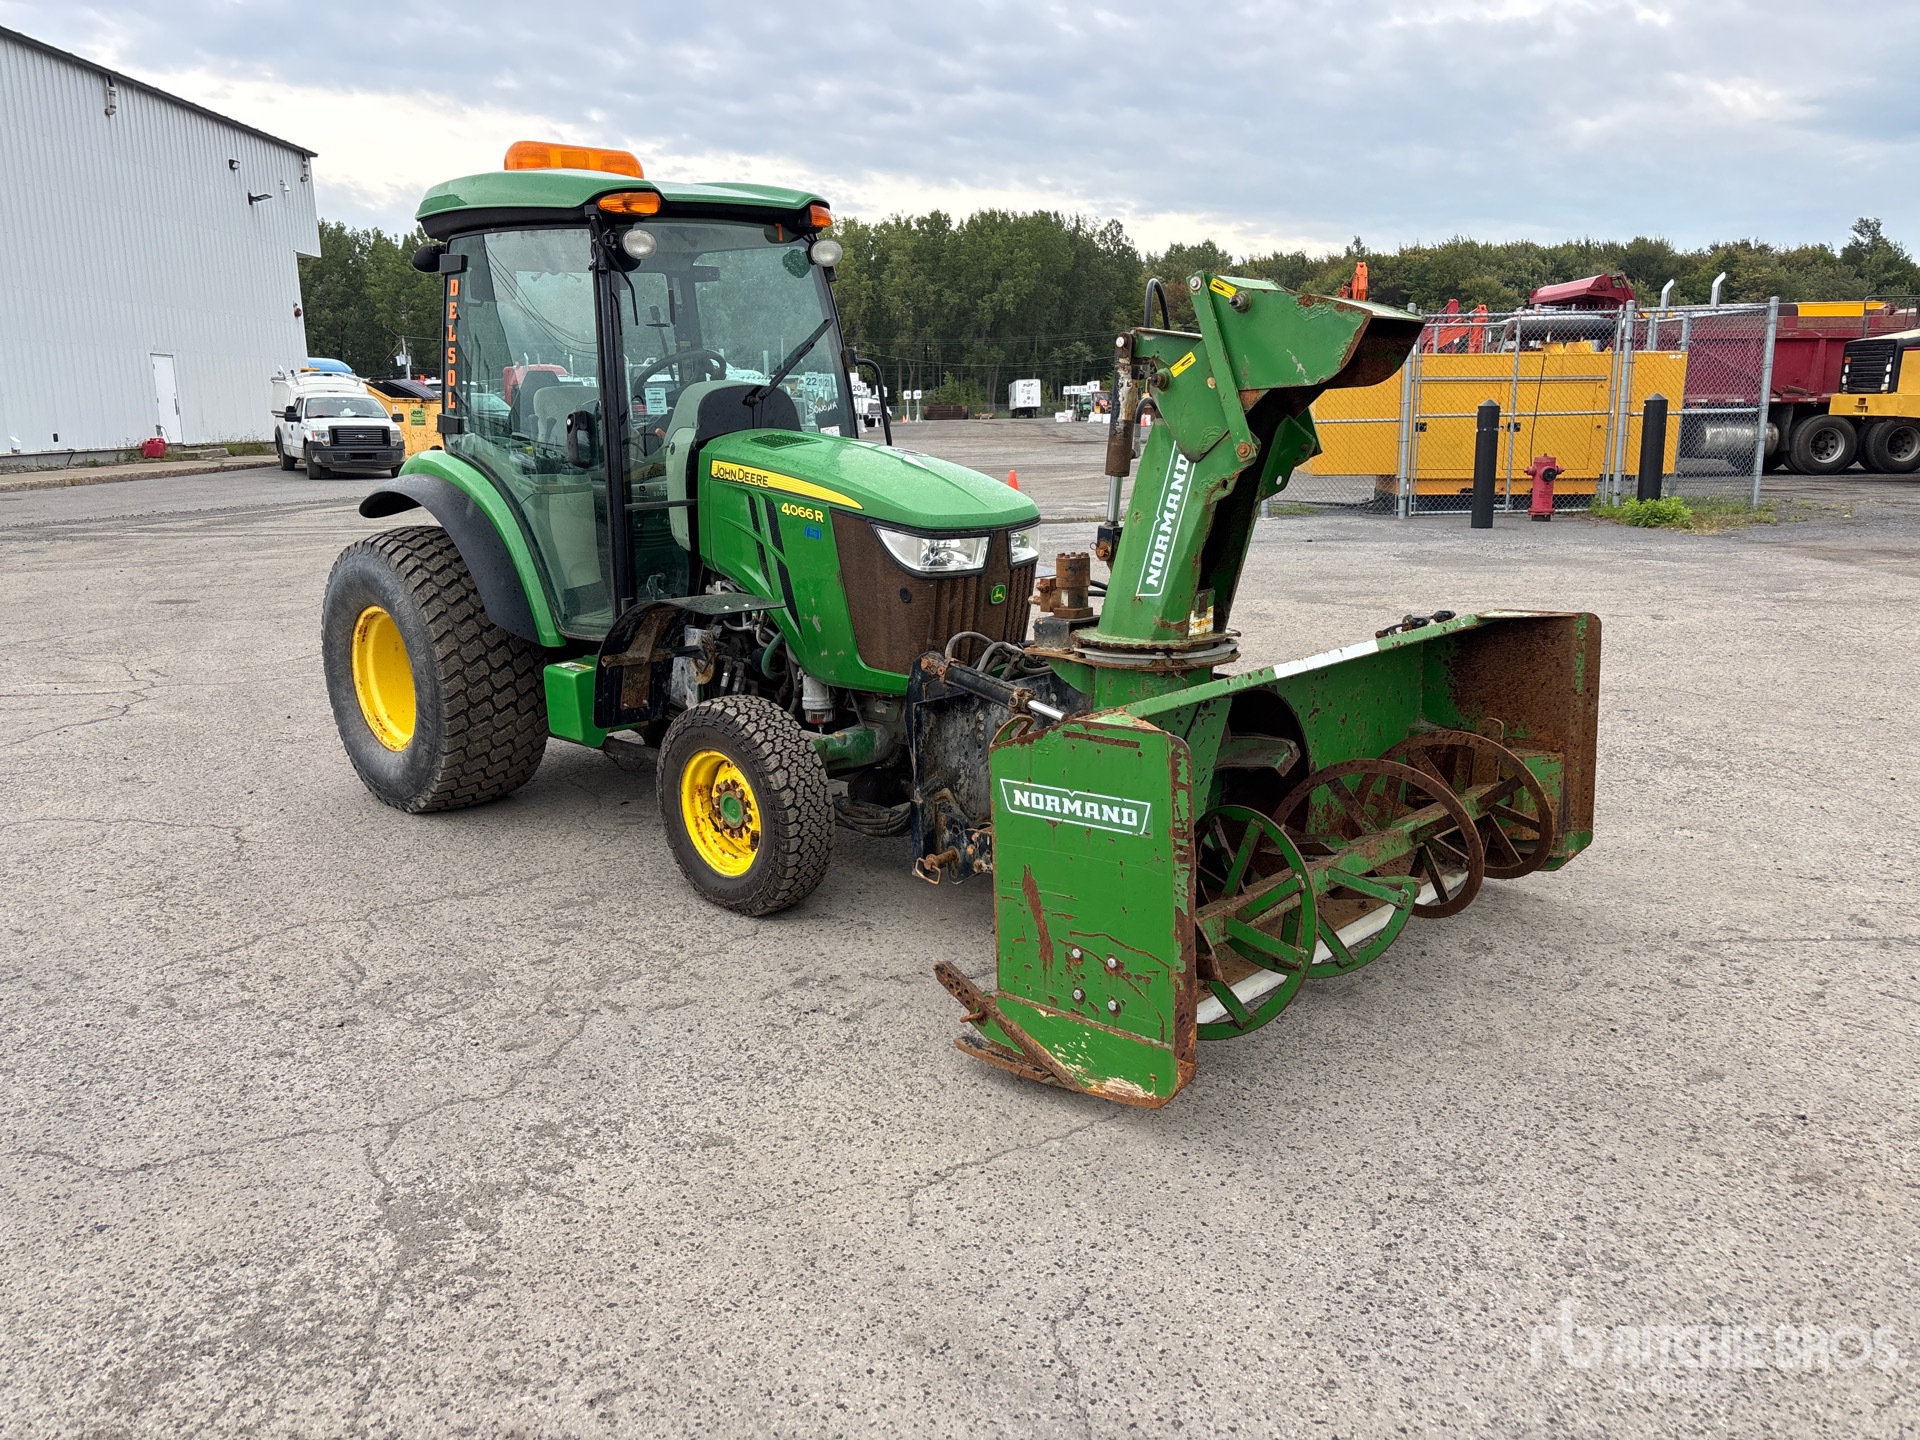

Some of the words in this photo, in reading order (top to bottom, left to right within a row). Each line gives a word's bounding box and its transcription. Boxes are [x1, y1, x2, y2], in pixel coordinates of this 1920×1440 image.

[448, 279, 459, 409] DELSOL
[806, 377, 817, 386] 22
[852, 384, 862, 392] 20
[714, 464, 737, 480] JOHN
[737, 468, 769, 486] DEERE
[781, 502, 824, 523] 4066R
[1146, 453, 1190, 588] NORMAND
[1013, 789, 1138, 827] NORMAND
